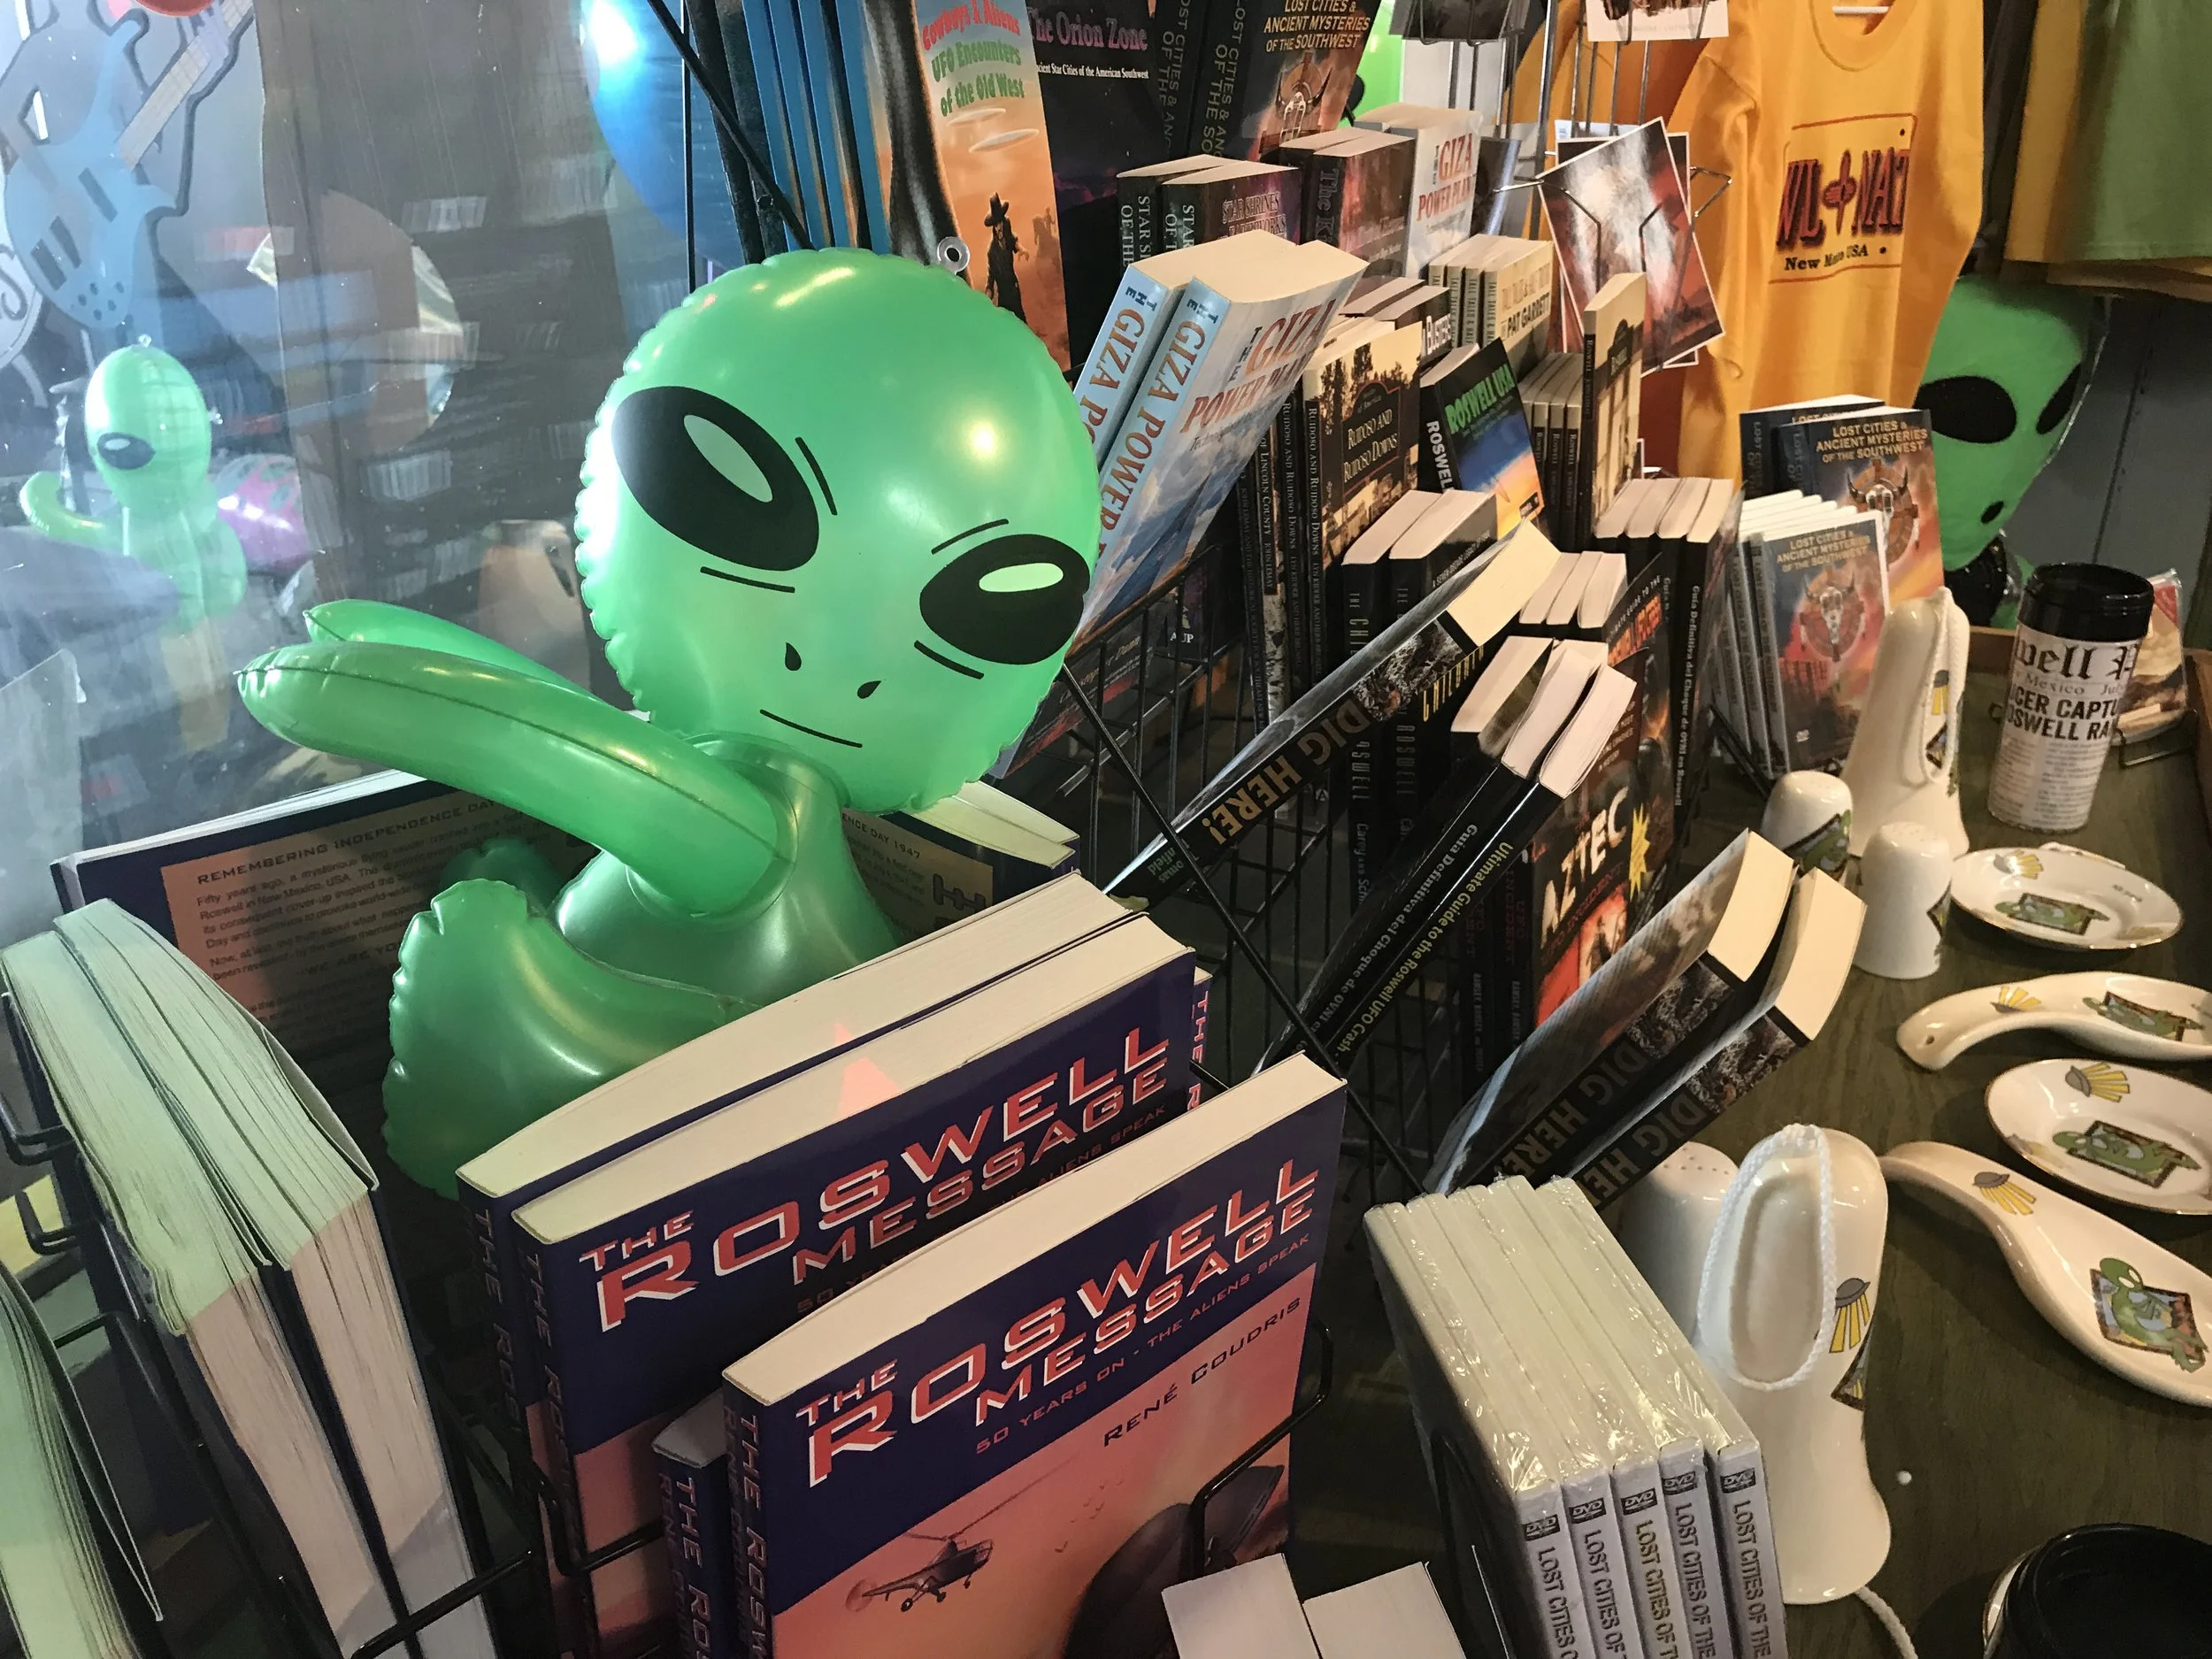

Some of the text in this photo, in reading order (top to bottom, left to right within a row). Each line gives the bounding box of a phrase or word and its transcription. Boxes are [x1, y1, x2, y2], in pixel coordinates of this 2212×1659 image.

[1056, 12, 1104, 48] Orion
[1106, 18, 1148, 51] Zone
[1162, 31, 1174, 58] OF
[1263, 15, 1371, 34] ANCIENT MYSTERIES
[1266, 34, 1361, 52] OF THE SOUTHWEST
[932, 40, 1021, 82] UFO Encounters
[1051, 63, 1063, 74] Star
[1063, 64, 1079, 76] Cities
[1086, 66, 1095, 77] the
[1095, 66, 1122, 78] American
[1122, 67, 1149, 79] Southwest
[1168, 34, 1186, 91] CITIES
[1214, 44, 1228, 70] OF
[1221, 49, 1239, 105] CITIES
[941, 73, 1025, 117] of the Old West
[1157, 65, 1170, 106] THE
[1205, 79, 1224, 119] THE
[1438, 133, 1473, 181] GIZA
[1138, 196, 1151, 242] STAR
[1417, 184, 1451, 220] POWER
[1120, 205, 1135, 266] OF THE
[1164, 213, 1178, 237] OF
[1182, 204, 1195, 248] STAR
[1784, 257, 1821, 272] New
[1125, 285, 1158, 312] THE
[1469, 279, 1478, 294] TALL
[1487, 281, 1498, 320] TALL TALES
[1186, 298, 1219, 326] THE
[1506, 292, 1551, 338] PAT GARRETT
[1089, 307, 1147, 391] GIZA
[1246, 299, 1337, 376] GIZA
[1099, 320, 1206, 532] GIZA POWER
[1445, 376, 1498, 434] ROSWELL
[1309, 408, 1317, 451] RUIDOSO
[1816, 428, 1929, 453] ANCIENT MYSTERIES
[1832, 425, 1860, 439] LOST
[1862, 420, 1899, 435] CITIES
[1260, 452, 1270, 494] LINCOLN
[1822, 442, 1925, 465] OF THE SOUTHWEST
[1286, 472, 1295, 513] RUIDOSO
[1310, 477, 1320, 519] RUIDOSO
[1262, 495, 1271, 535] COUNTY
[1287, 516, 1297, 549] DOWNS
[1311, 522, 1320, 557] DOWNS
[1776, 535, 1871, 564] ANCIENT MYSTERIES
[1789, 533, 1847, 551] LOST CITIES
[2024, 672, 2085, 695] Mexico
[1296, 699, 1372, 766] DIG
[1201, 755, 1303, 846] HERE!
[197, 843, 329, 885] REMEMBERING
[333, 807, 464, 849] INDEPENDENCE
[871, 827, 921, 860] DAY 1947
[1464, 841, 1514, 893] Ultimate
[1540, 785, 1627, 950] AZTEC
[196, 893, 222, 907] Fifty
[227, 885, 257, 901] years
[199, 902, 244, 921] Roswell
[1437, 891, 1471, 927] Guide
[1319, 855, 1455, 1024] Definitiva del Choque de OVNI
[1411, 939, 1432, 960] the
[1427, 923, 1444, 941] to
[1380, 956, 1418, 1003] Roswell
[1191, 989, 1210, 1064] THE
[1360, 999, 1386, 1029] UFO
[1336, 1023, 1367, 1054] Crash
[1578, 1040, 1645, 1107] DIG
[1109, 1103, 1167, 1146] SPEAK
[1632, 1091, 1709, 1158] DIG
[597, 1026, 1171, 1333] ROSWELL
[792, 1056, 1169, 1286] MESSAGE
[475, 1209, 503, 1304] THE
[579, 1209, 695, 1272] THE
[524, 1252, 554, 1349] THE
[975, 1187, 1317, 1429] MESSAGE
[809, 1158, 1322, 1489] ROSWELL
[976, 1233, 1310, 1455] 50 YEARS ON THE ALIENS SPEAK
[796, 1359, 899, 1427] THE
[1102, 1296, 1304, 1448] RENÉ COUDRIS
[740, 1414, 762, 1511] THE
[675, 1476, 704, 1568] THE
[1635, 1518, 1661, 1565] LOST
[1676, 1502, 1699, 1549] LOST
[1732, 1500, 1758, 1544] LOST
[1584, 1528, 1608, 1576] LOST
[1645, 1568, 1671, 1620] CITIES
[1680, 1551, 1706, 1602] CITIES
[1740, 1548, 1764, 1600] CITIES
[1538, 1545, 1575, 1647] LOST CITIES
[1594, 1578, 1620, 1630] CITIES
[1689, 1605, 1710, 1627] OF
[1747, 1601, 1768, 1624] OF
[1604, 1632, 1626, 1655] OF
[1655, 1623, 1677, 1646] OF
[1694, 1627, 1717, 1659] THE
[1750, 1624, 1771, 1657] THE
